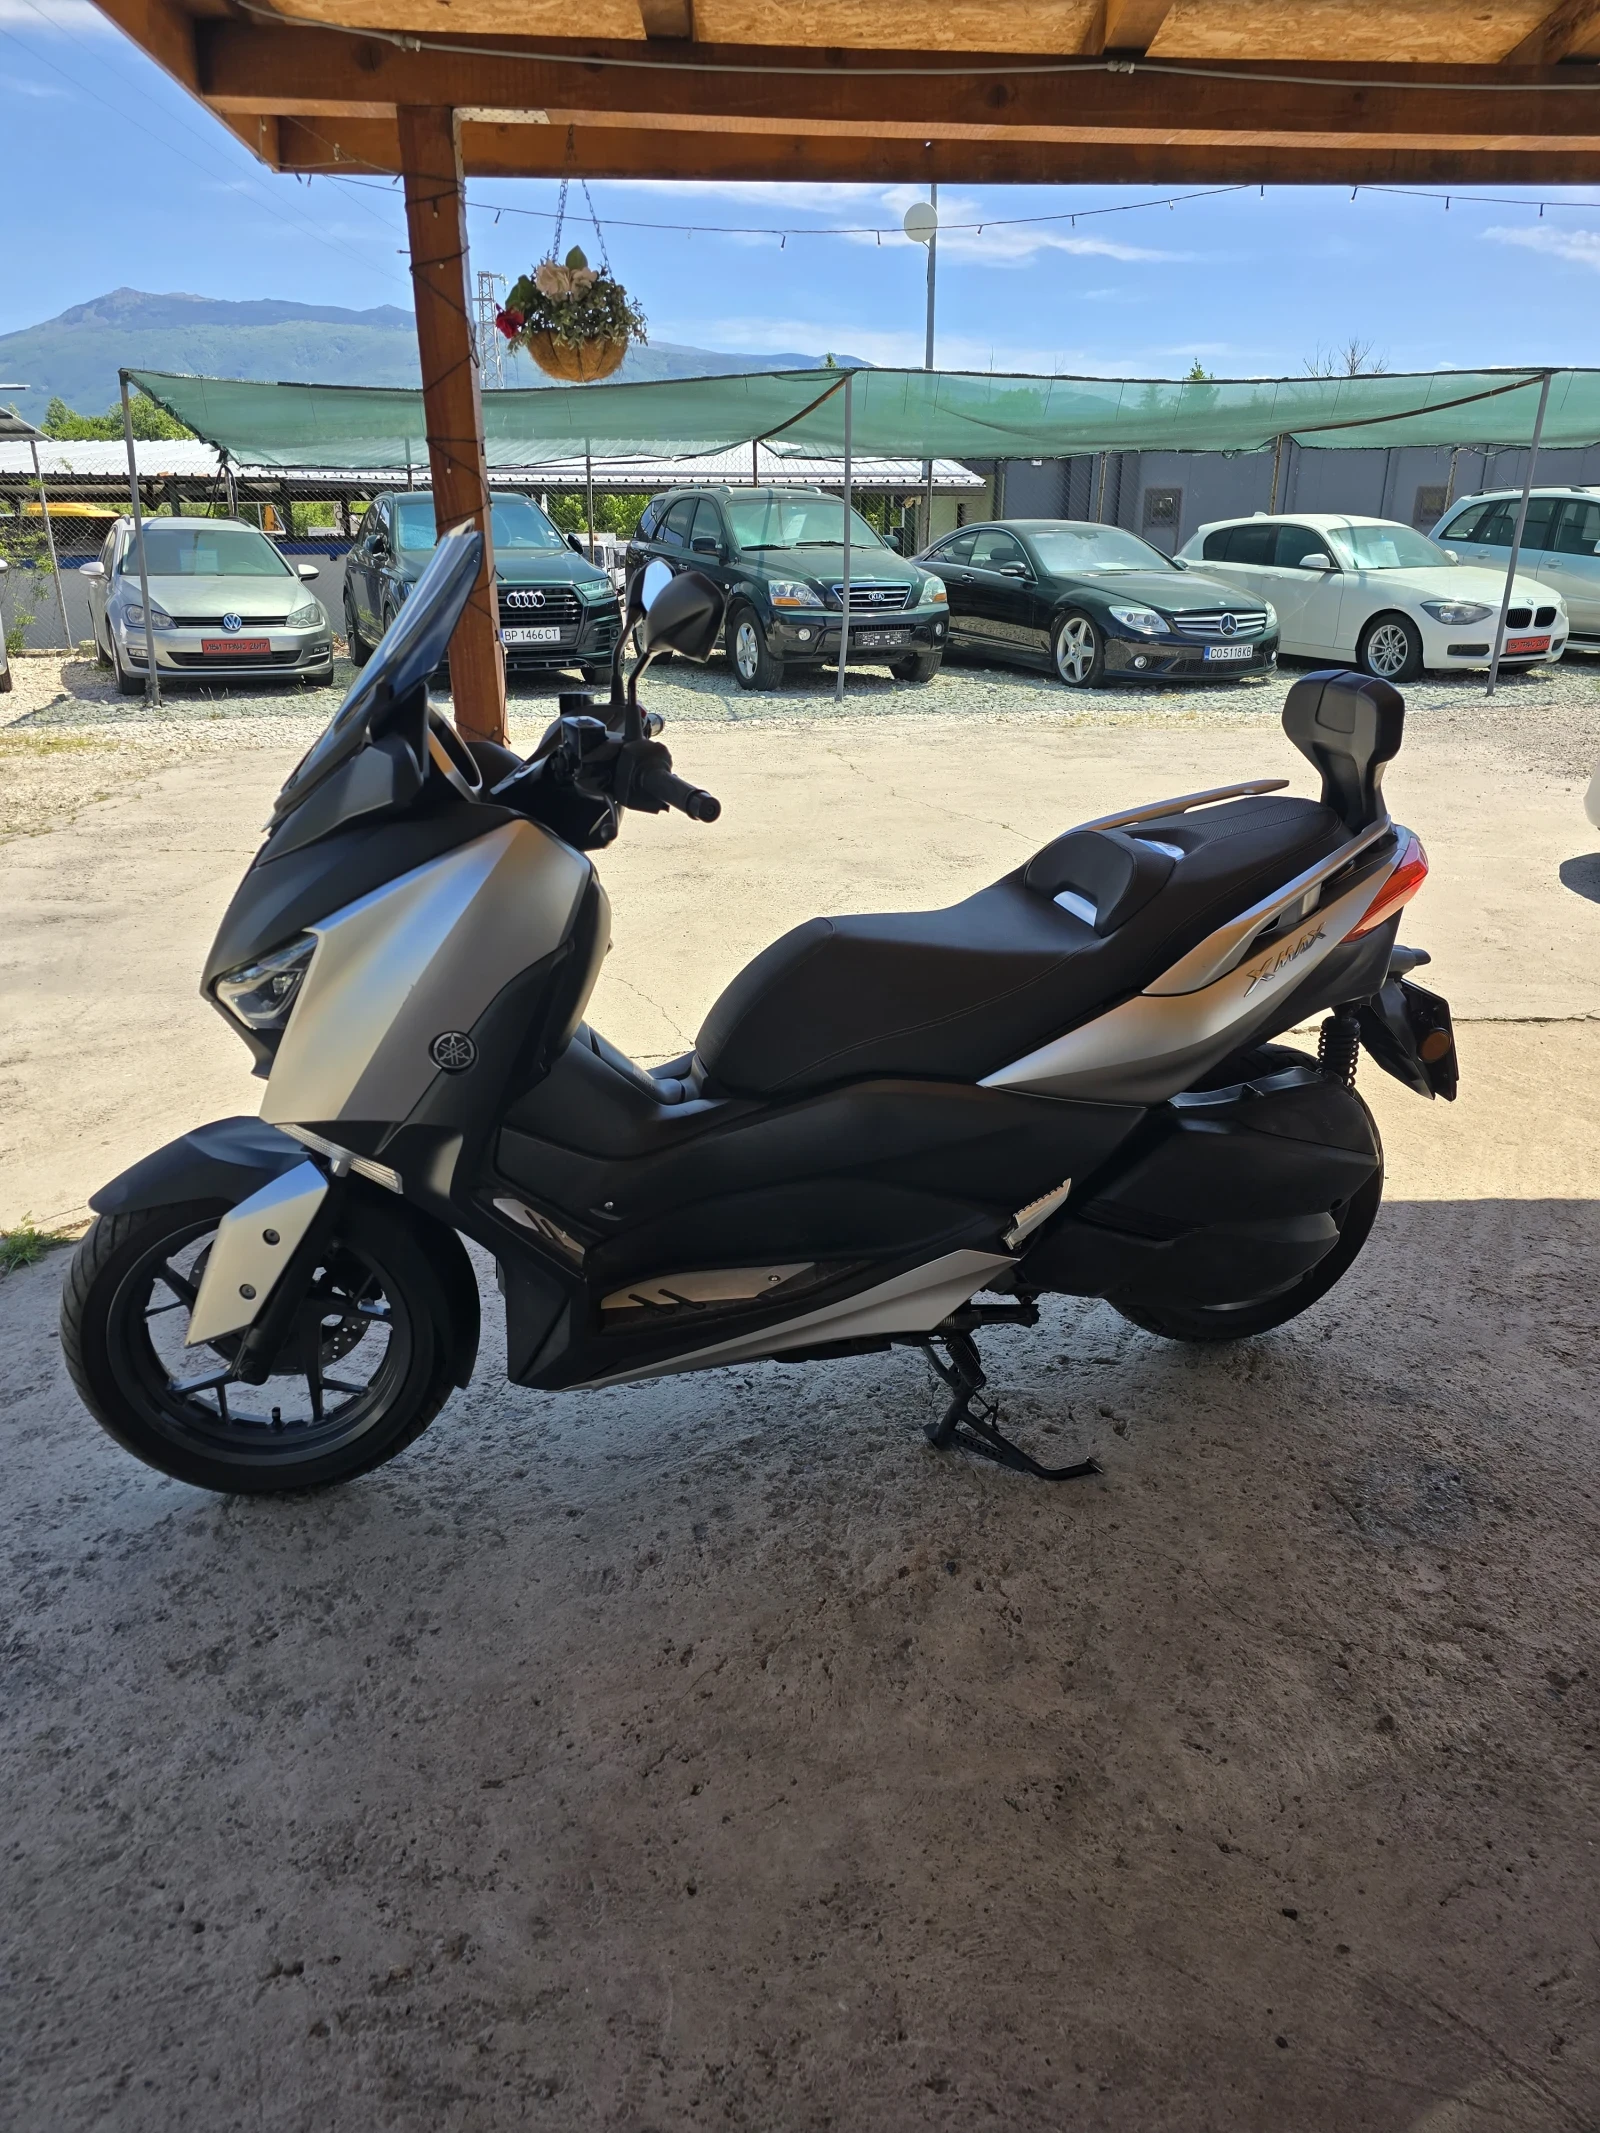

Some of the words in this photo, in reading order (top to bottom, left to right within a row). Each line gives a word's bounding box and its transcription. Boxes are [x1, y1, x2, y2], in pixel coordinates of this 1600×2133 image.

[505, 631, 518, 641] BP
[521, 630, 544, 641] 1466
[545, 629, 558, 640] CT
